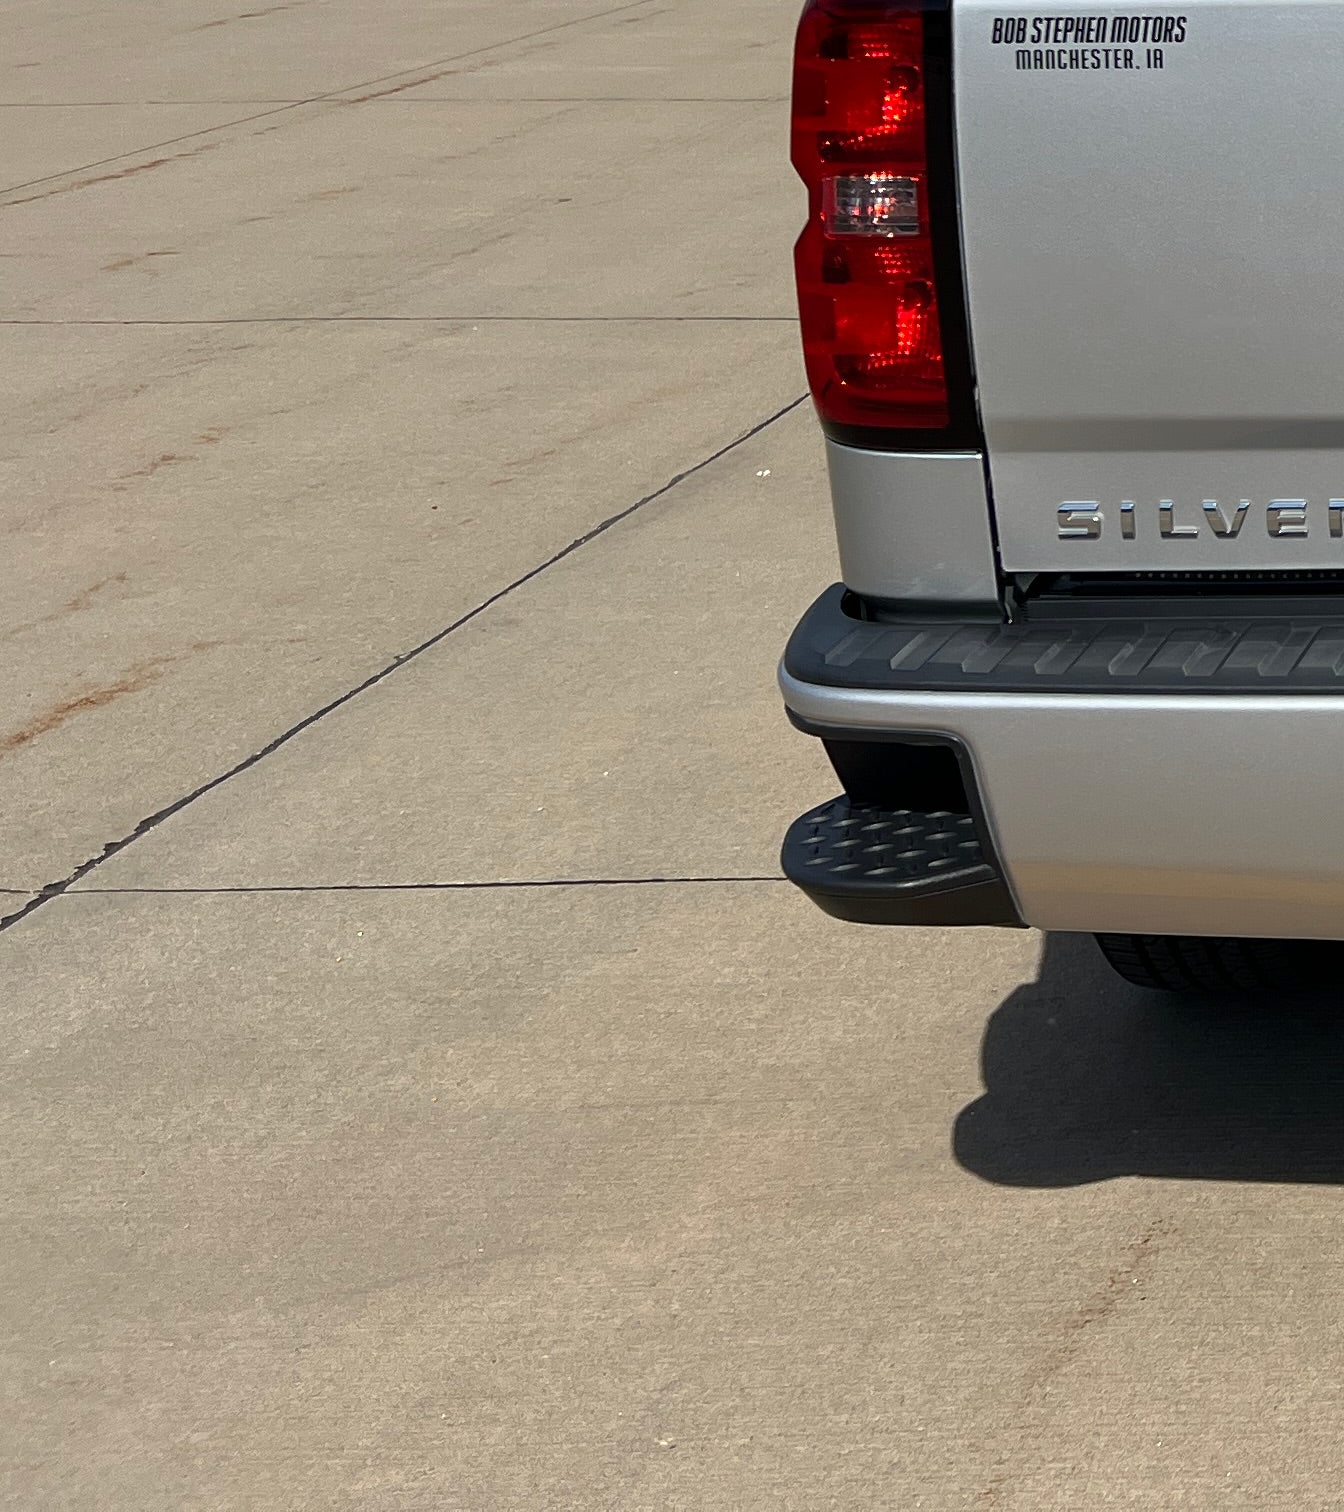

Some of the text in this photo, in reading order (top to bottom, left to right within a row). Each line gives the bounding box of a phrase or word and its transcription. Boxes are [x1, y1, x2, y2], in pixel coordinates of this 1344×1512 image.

[991, 16, 1187, 44] BOB STEPHEN MOTORS
[1147, 48, 1164, 69] IA
